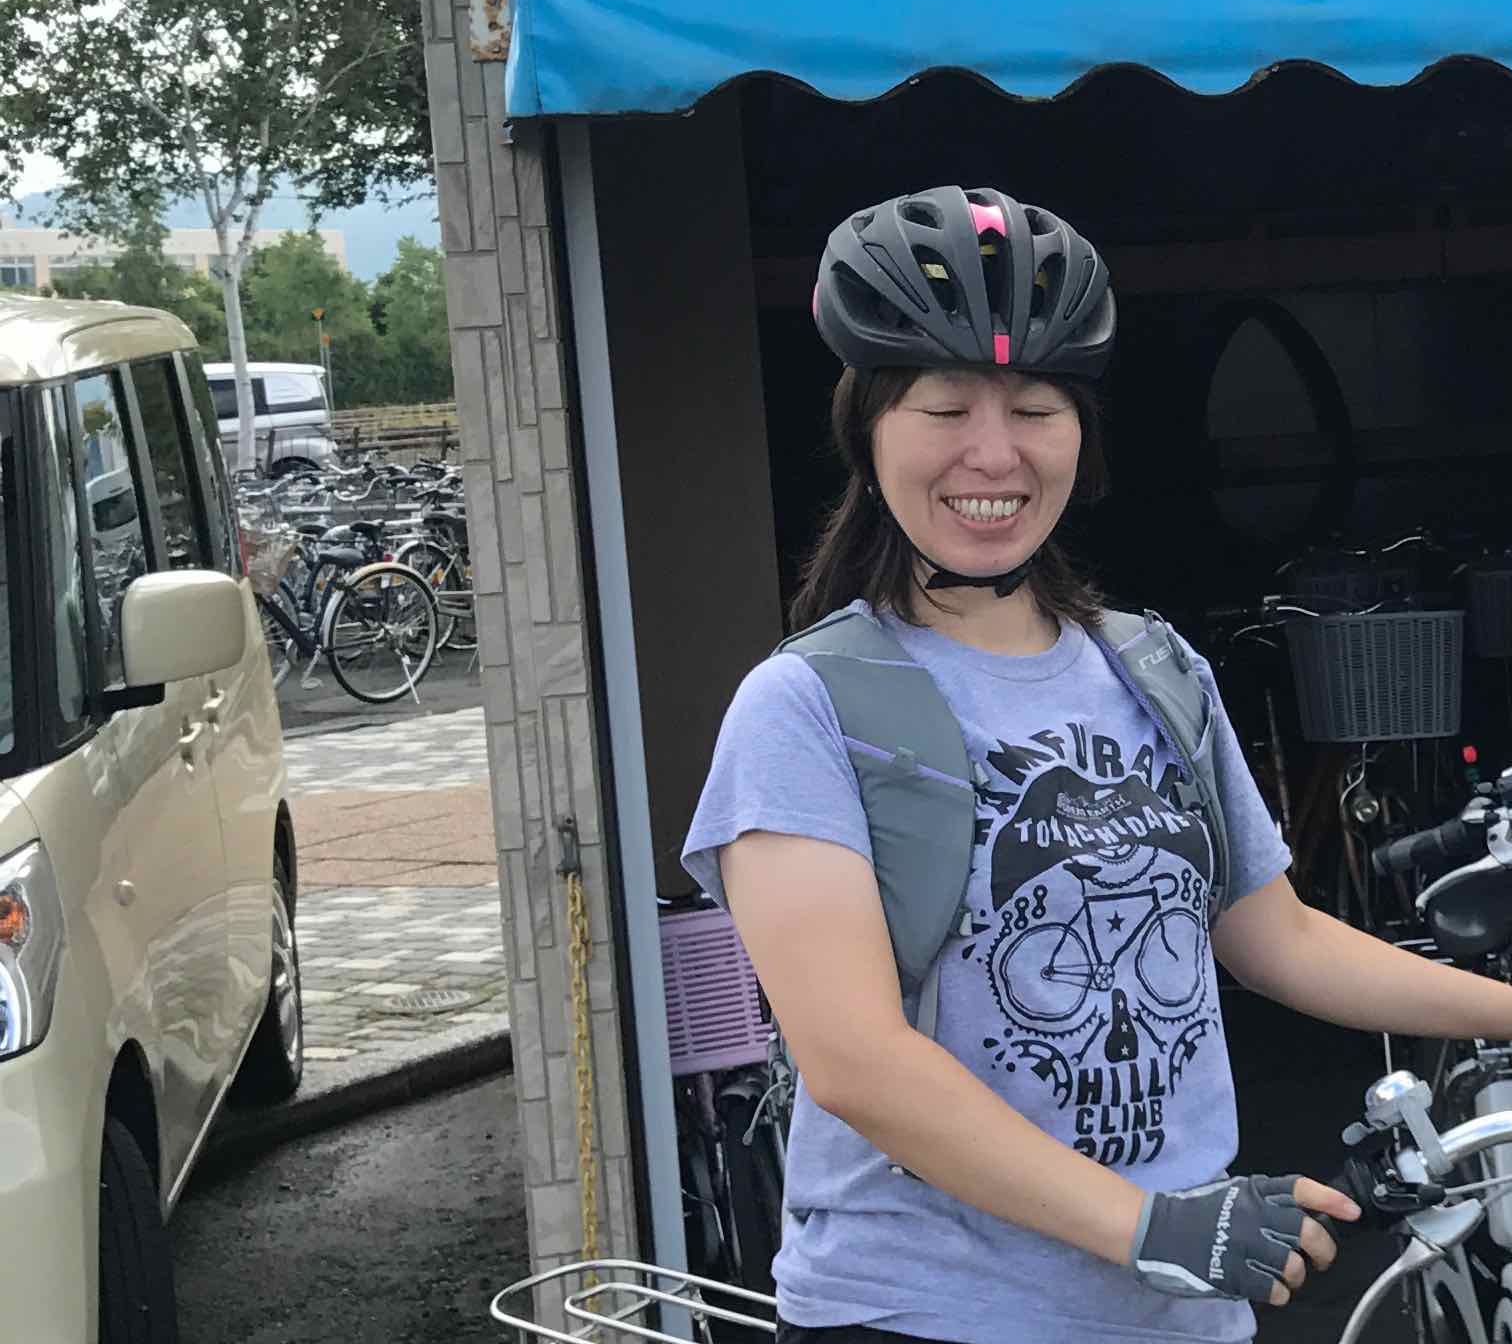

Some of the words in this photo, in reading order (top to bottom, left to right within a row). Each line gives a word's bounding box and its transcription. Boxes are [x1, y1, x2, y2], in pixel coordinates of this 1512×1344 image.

[1014, 805, 1191, 849] TOKACHIDAKE
[1075, 1057, 1166, 1107] HILL
[1073, 1128, 1165, 1166] 2017
